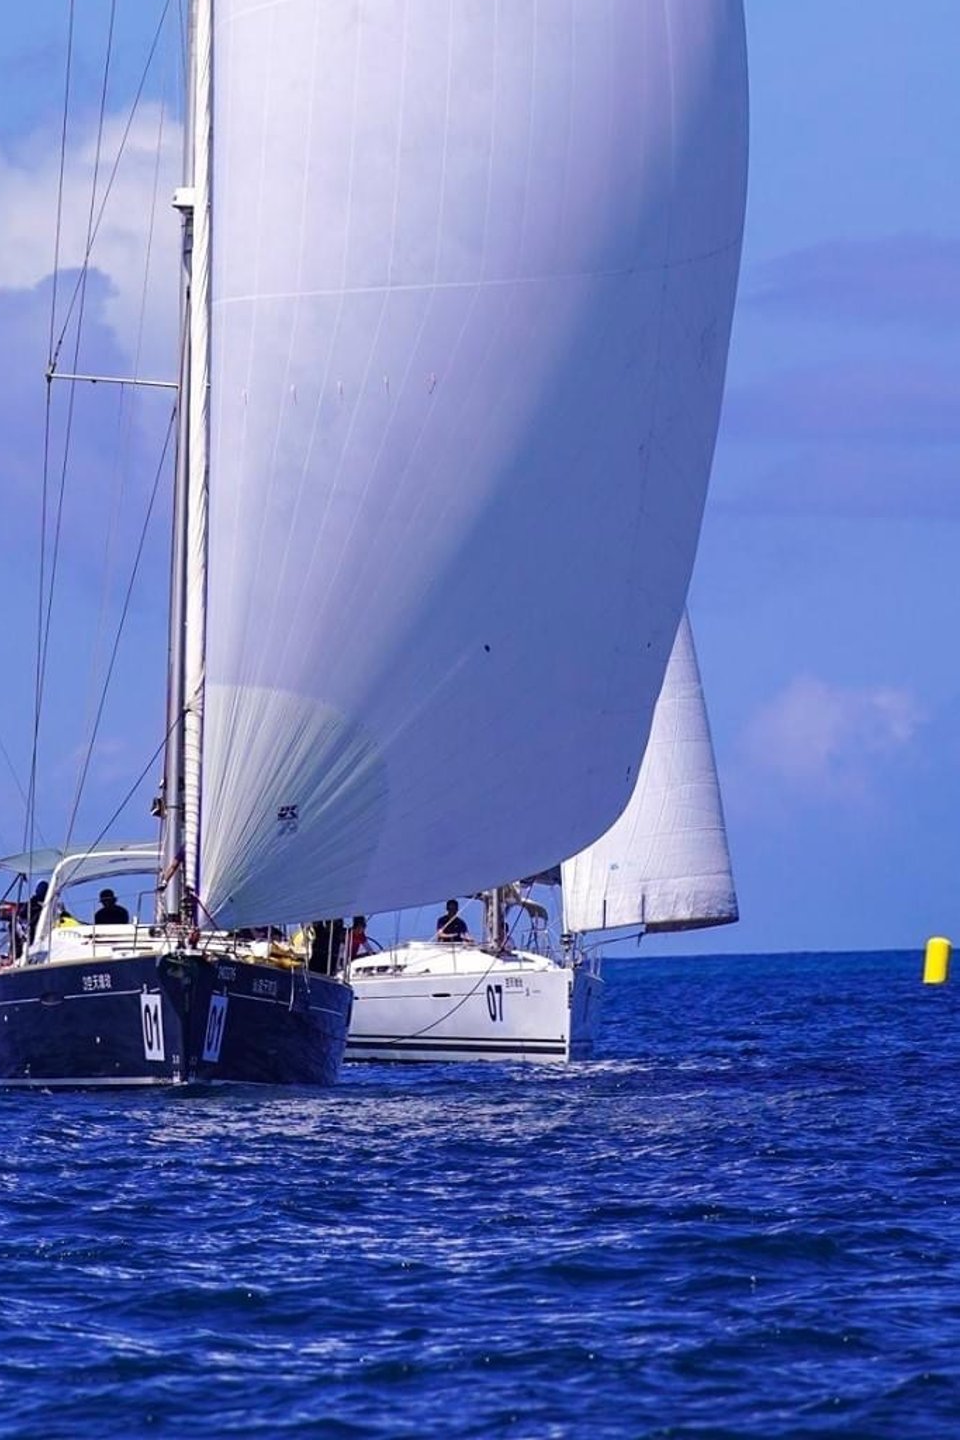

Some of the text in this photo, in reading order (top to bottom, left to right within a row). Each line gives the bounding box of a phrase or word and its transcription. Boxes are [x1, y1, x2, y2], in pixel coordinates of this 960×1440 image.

[487, 984, 503, 1022] 07
[144, 1004, 160, 1051] 01
[206, 1004, 224, 1052] 01
